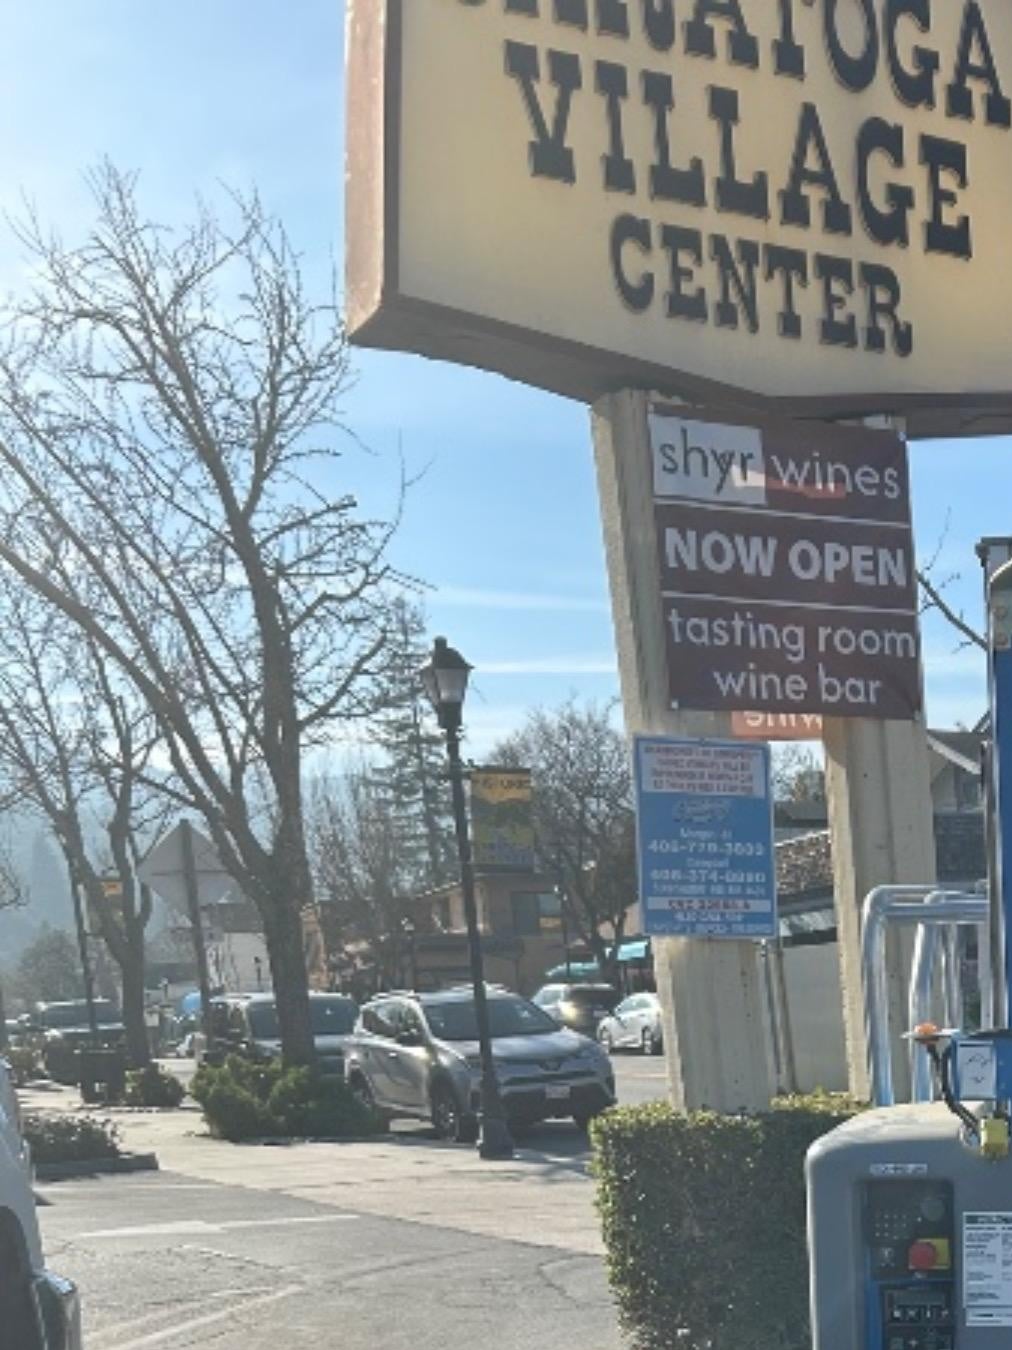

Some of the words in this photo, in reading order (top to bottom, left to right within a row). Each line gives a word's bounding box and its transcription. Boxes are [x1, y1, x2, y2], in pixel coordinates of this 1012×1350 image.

[504, 40, 973, 259] VILLAGE
[609, 213, 913, 356] CENTER
[659, 427, 753, 494] shyr
[771, 452, 900, 498] wines
[664, 527, 777, 577] NOW
[788, 540, 907, 586] OPEN
[668, 608, 805, 663] tasting
[818, 625, 916, 658] room
[713, 663, 808, 702] wine
[818, 663, 882, 704] bar
